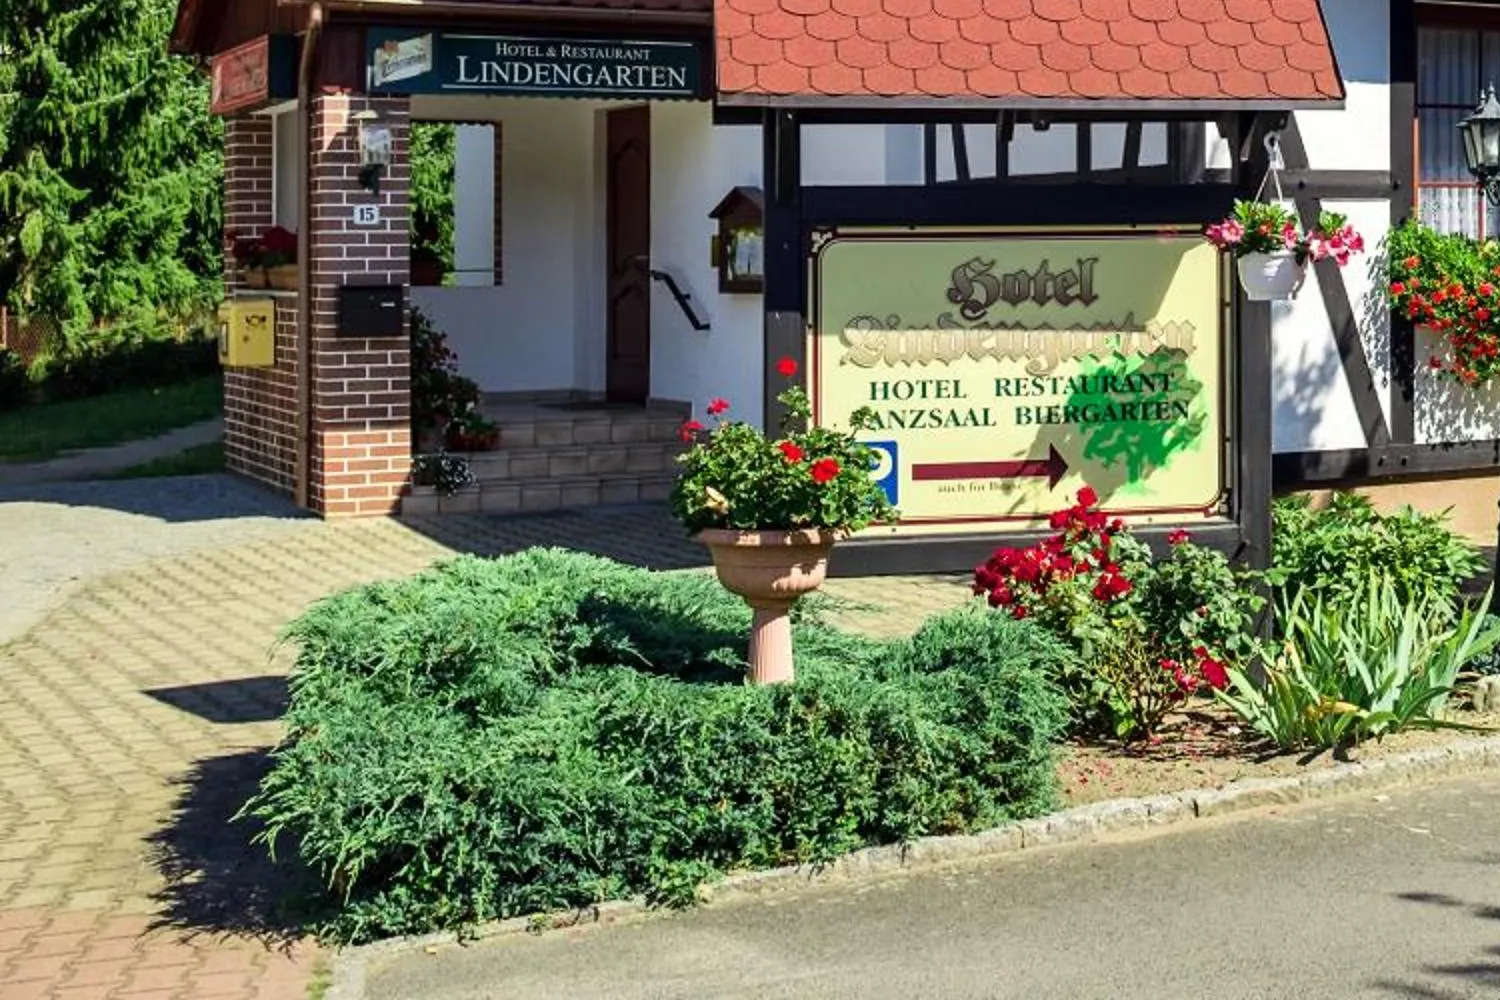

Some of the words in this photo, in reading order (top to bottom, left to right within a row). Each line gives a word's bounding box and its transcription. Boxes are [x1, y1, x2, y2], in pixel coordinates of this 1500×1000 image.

[545, 46, 557, 58] &
[456, 55, 686, 88] LINDENGARTEN
[359, 207, 375, 222] 15
[946, 256, 1099, 321] Hotel
[839, 311, 1197, 376] Lindengarten
[869, 379, 967, 400] HOTEL
[994, 372, 1174, 398] RESTAURANT
[858, 407, 997, 431] ANZSAAL
[1014, 399, 1190, 426] BIERGARTEN
